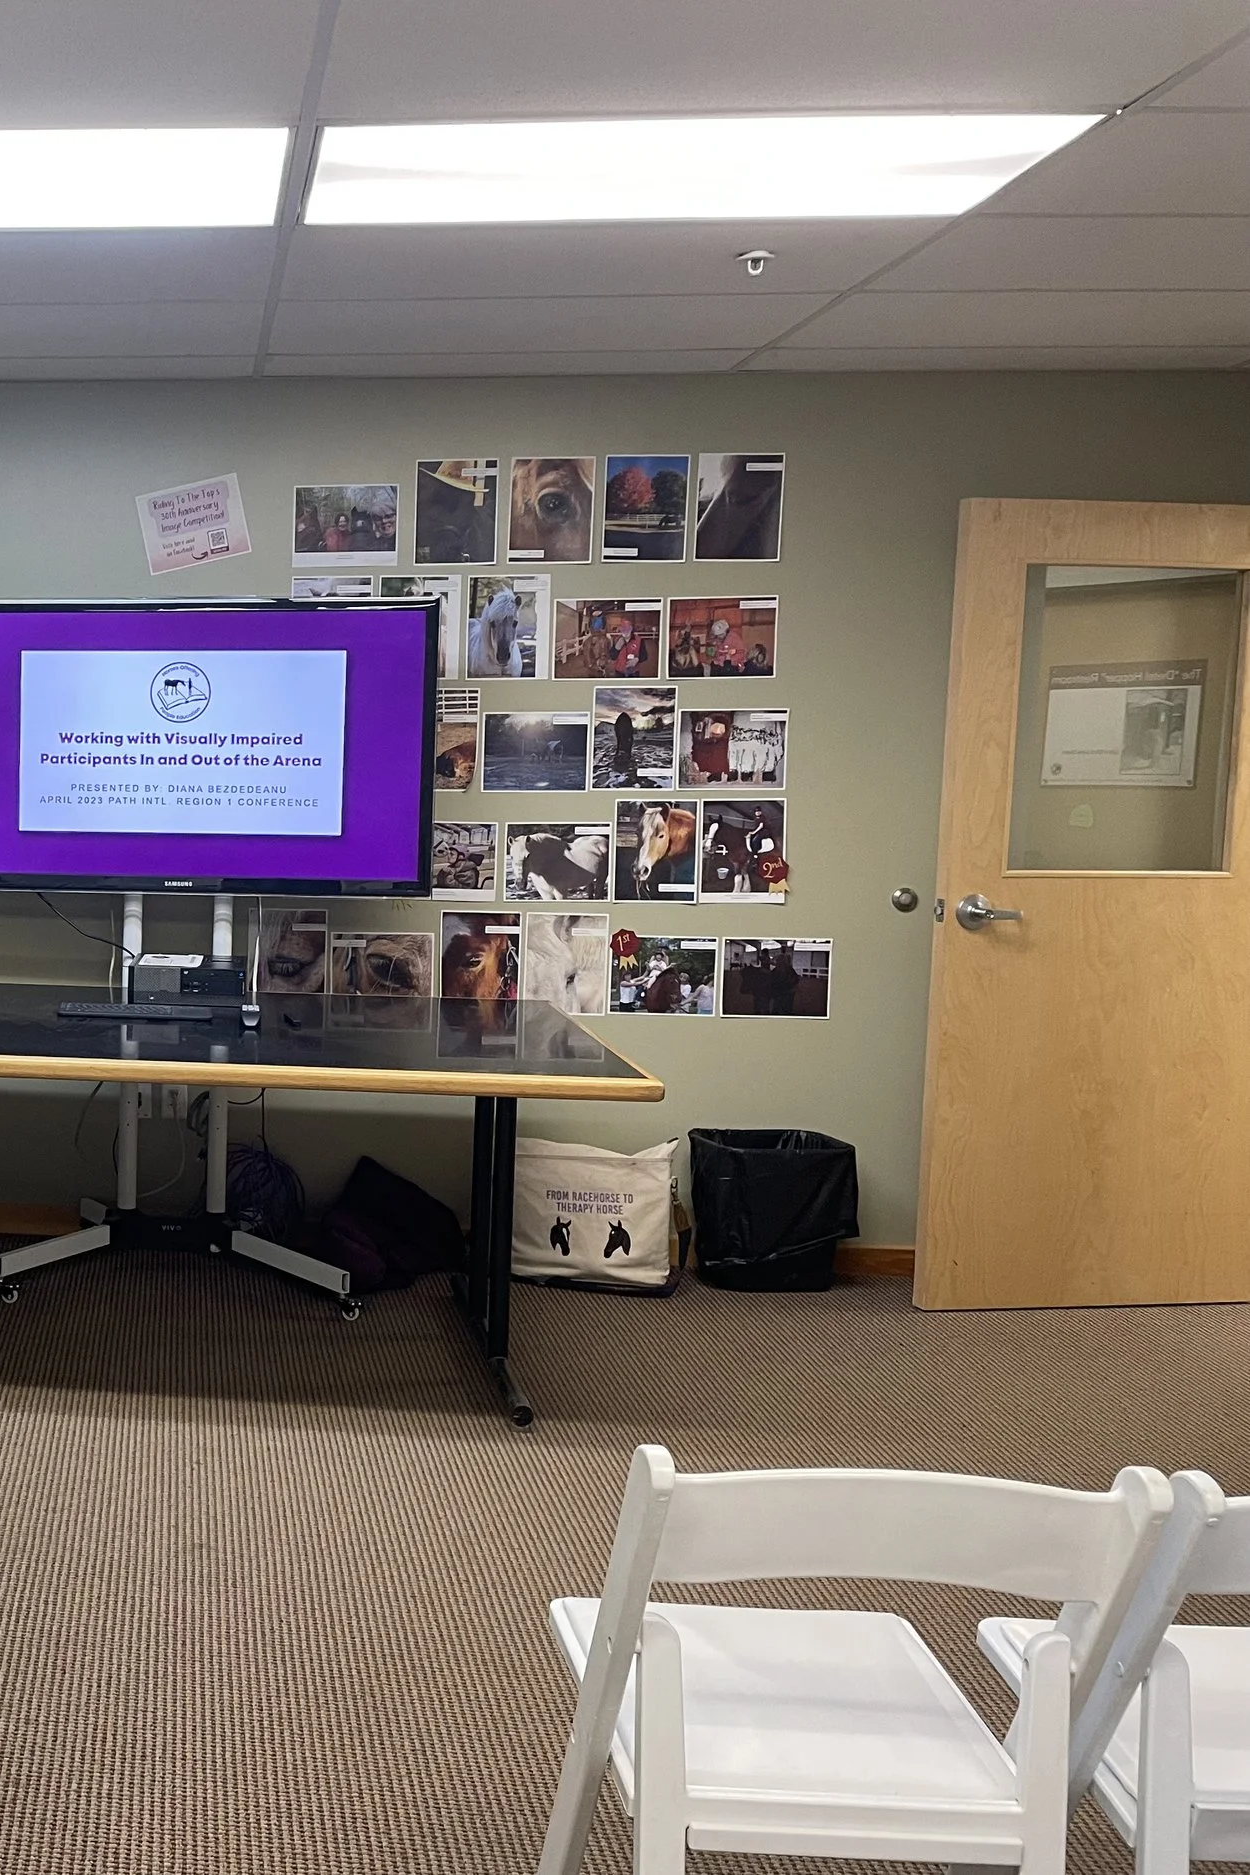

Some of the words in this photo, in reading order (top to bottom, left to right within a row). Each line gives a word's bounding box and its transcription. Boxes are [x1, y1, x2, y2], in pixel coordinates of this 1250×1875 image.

[176, 496, 185, 505] To
[186, 493, 200, 502] The
[178, 501, 219, 517] Anniversary
[161, 523, 182, 533] Image
[59, 732, 123, 747] Working
[127, 732, 161, 744] with
[164, 732, 227, 748] Visually
[231, 733, 303, 748] Impaired
[40, 752, 137, 767] Participants
[140, 754, 154, 765] In
[158, 754, 188, 766] and
[191, 754, 220, 766] Out
[223, 754, 240, 766] of
[243, 754, 270, 766] the
[273, 755, 322, 767] Arena
[71, 783, 139, 792] PRESENTED
[168, 785, 203, 793] DIANA
[207, 785, 287, 794] BEZDEDEANU
[39, 796, 72, 804] APRIL
[77, 796, 103, 804] 2023
[108, 796, 137, 805] PATH
[176, 797, 222, 806] REGION
[227, 798, 232, 806] 1
[237, 798, 319, 807] CONFERENCE
[762, 857, 784, 878] 2nd
[617, 933, 630, 951] 1st
[546, 1190, 569, 1201] FROM
[572, 1191, 620, 1203] RACEHORSE
[623, 1193, 634, 1204] TO
[556, 1202, 594, 1213] THERAPY
[596, 1203, 624, 1215] HORSE
